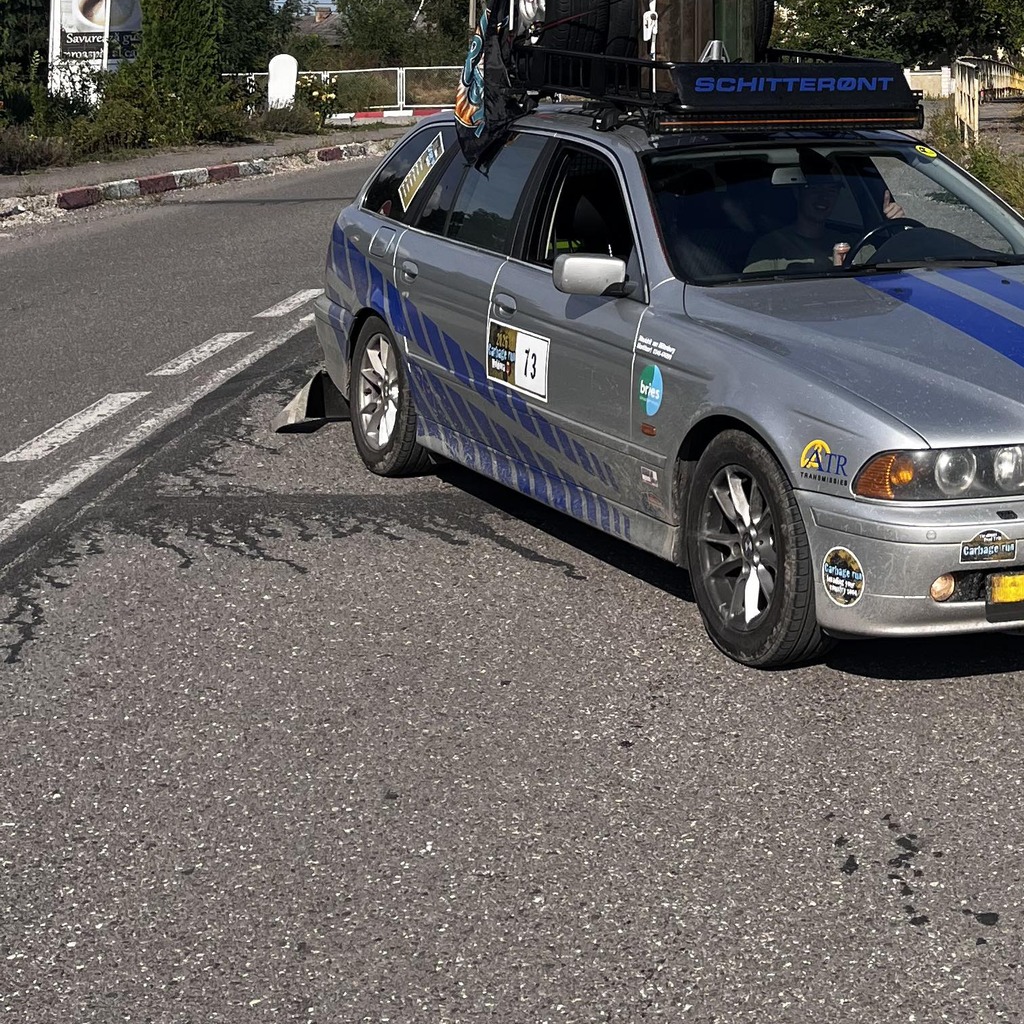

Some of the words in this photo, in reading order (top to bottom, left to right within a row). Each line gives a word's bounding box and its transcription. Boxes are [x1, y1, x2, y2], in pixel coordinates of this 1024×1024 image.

[694, 77, 894, 93] SCHITTERØNT
[524, 347, 537, 380] 73
[639, 379, 660, 400] bries
[803, 448, 848, 477] ATR
